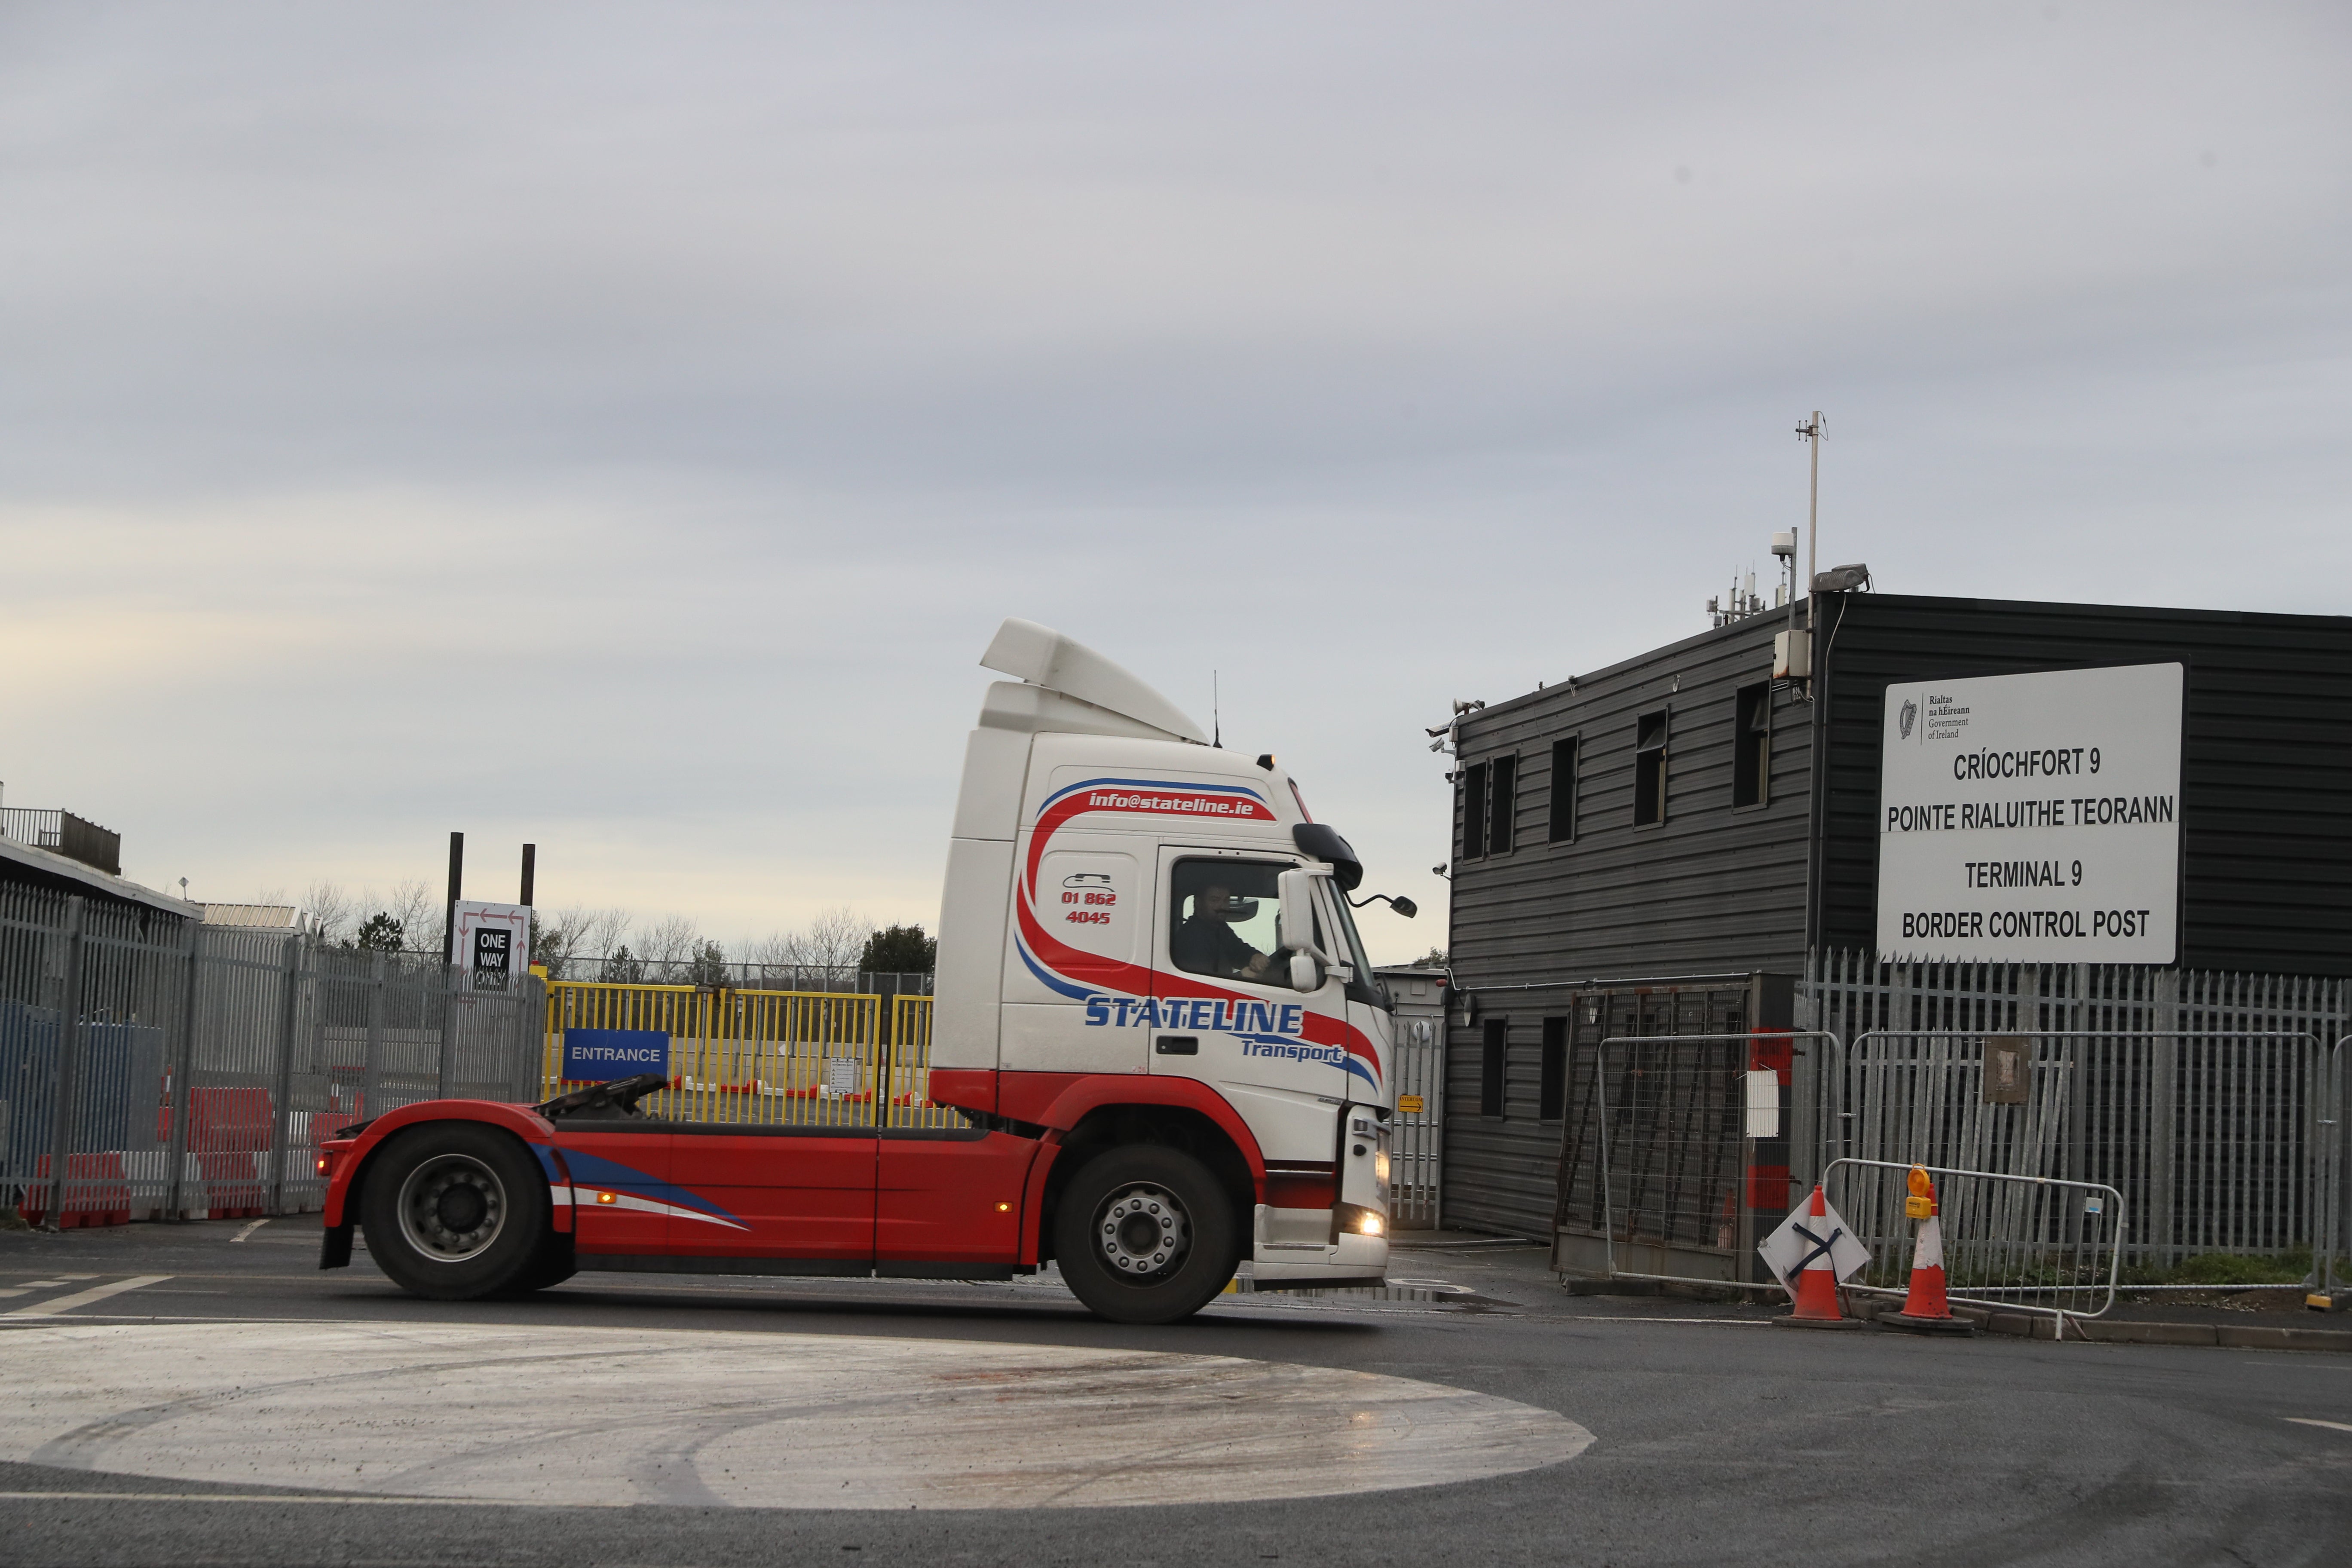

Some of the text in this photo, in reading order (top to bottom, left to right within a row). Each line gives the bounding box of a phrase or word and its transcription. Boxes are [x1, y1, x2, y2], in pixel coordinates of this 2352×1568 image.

[1929, 695, 1952, 704] Rialtas
[1939, 704, 1969, 715] hÉireann
[1929, 718, 1969, 728] Government
[1928, 729, 1959, 739] of Ireland
[1954, 747, 2101, 780] CRÍOCHFORT 9
[1089, 793, 1254, 815] info@stateline.ie
[1888, 795, 2173, 832] POINTE RIALUITHE TEORANN
[1965, 860, 2082, 888] TERMINAL 9
[1061, 891, 1116, 906] 01 862
[1066, 911, 1110, 925] 4045
[1903, 910, 2150, 938] BORDER CONTROL POST
[480, 933, 505, 948] ONE
[480, 952, 504, 967] WAY
[1085, 997, 1302, 1033] STATELINE
[572, 1047, 660, 1062] ENTRANCE
[1242, 1040, 1343, 1062] Transport
